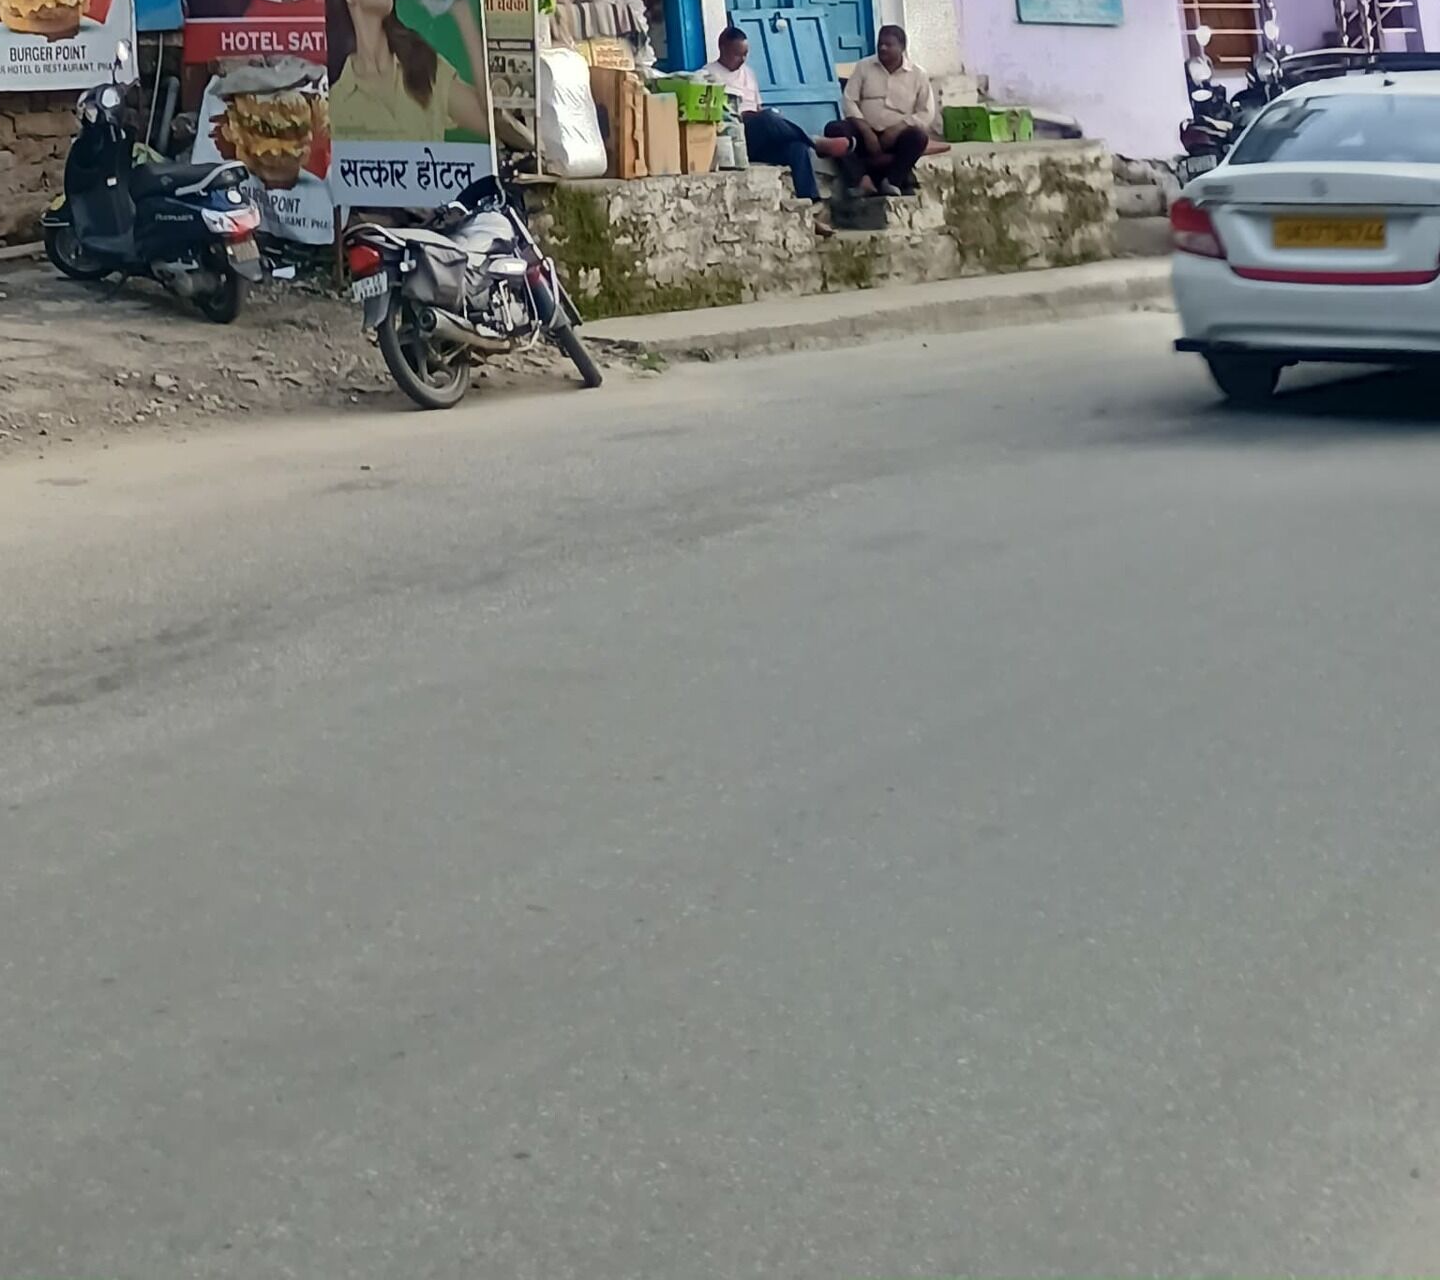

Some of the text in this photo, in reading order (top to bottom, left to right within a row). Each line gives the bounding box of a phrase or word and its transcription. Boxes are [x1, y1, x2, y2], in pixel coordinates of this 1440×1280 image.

[221, 31, 284, 51] HOTEL
[10, 45, 86, 62] BURGER POINT
[8, 64, 32, 74] HOTEL
[340, 147, 475, 190] सत्कार होटल
